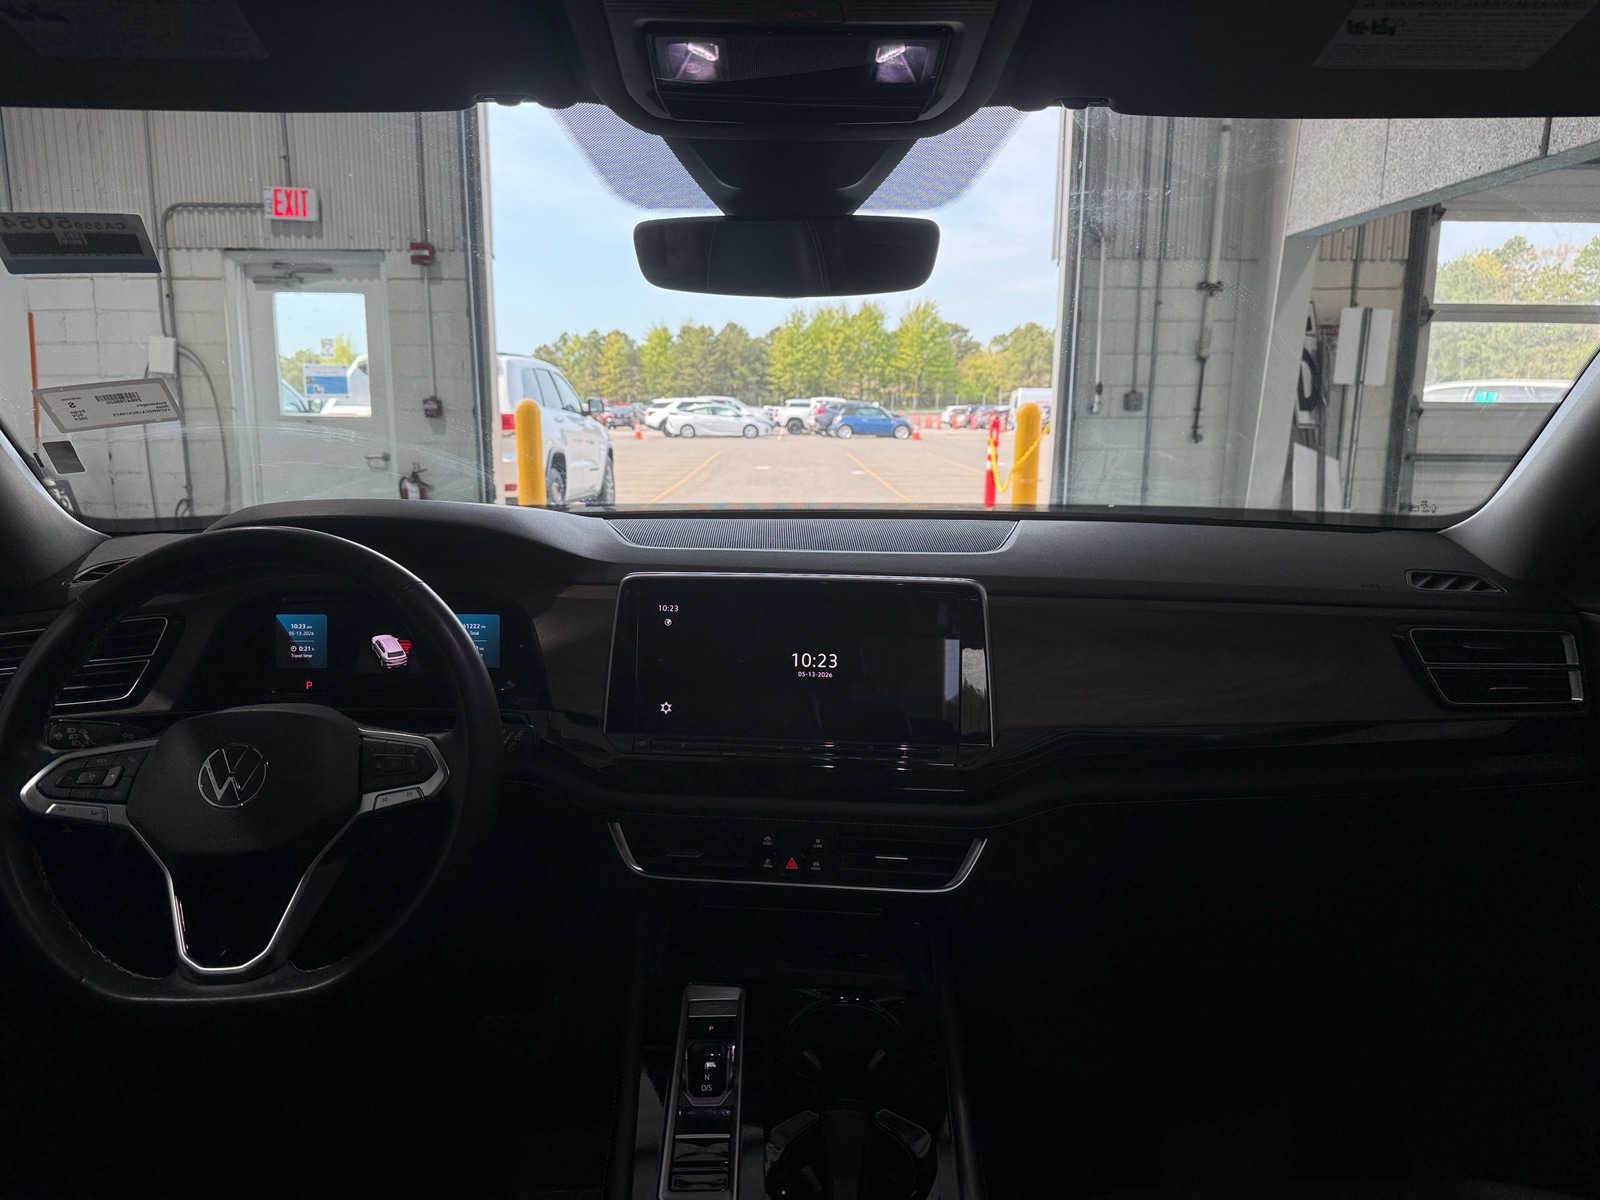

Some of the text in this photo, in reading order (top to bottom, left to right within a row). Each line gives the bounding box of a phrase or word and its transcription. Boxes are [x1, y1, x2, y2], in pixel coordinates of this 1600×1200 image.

[273, 188, 308, 218] EXIT
[658, 604, 679, 612] 10:23
[792, 652, 838, 668] 10:23
[306, 680, 313, 690] P
[701, 1084, 713, 1092] D/S
